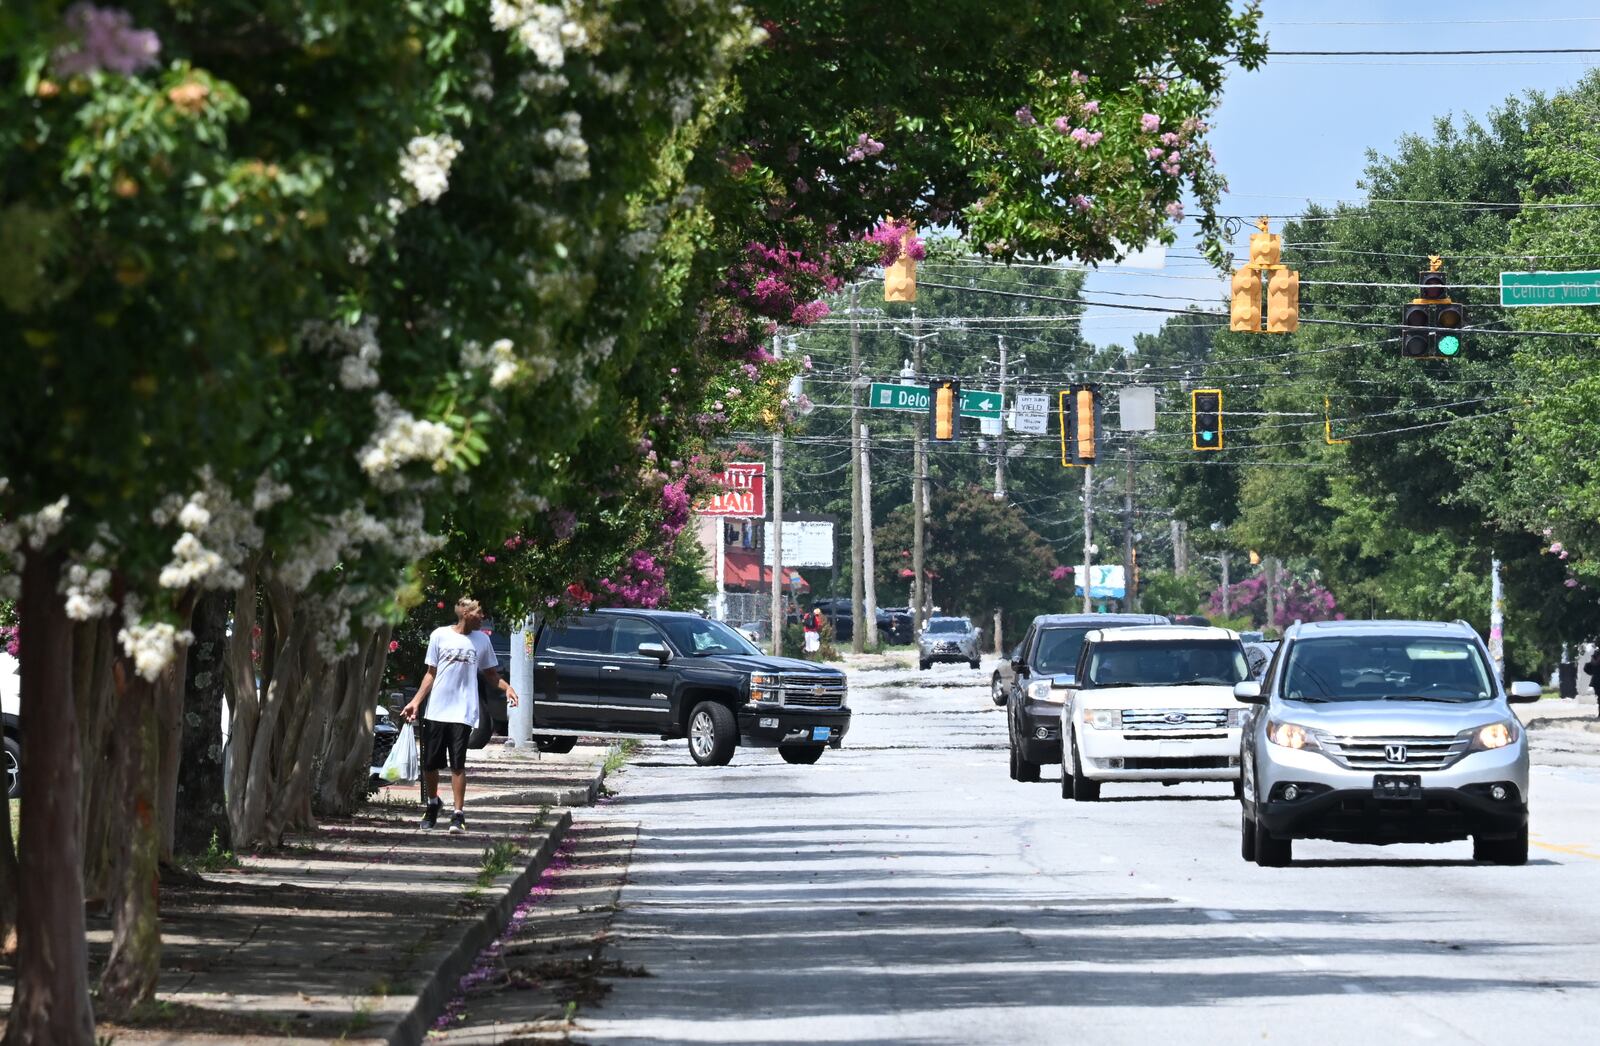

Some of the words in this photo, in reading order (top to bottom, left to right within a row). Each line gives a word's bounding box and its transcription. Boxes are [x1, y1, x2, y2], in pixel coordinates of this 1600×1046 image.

[1512, 282, 1555, 298] Centra
[898, 390, 930, 407] Delo
[1021, 403, 1043, 411] YIELD
[693, 491, 754, 512] LLAR
